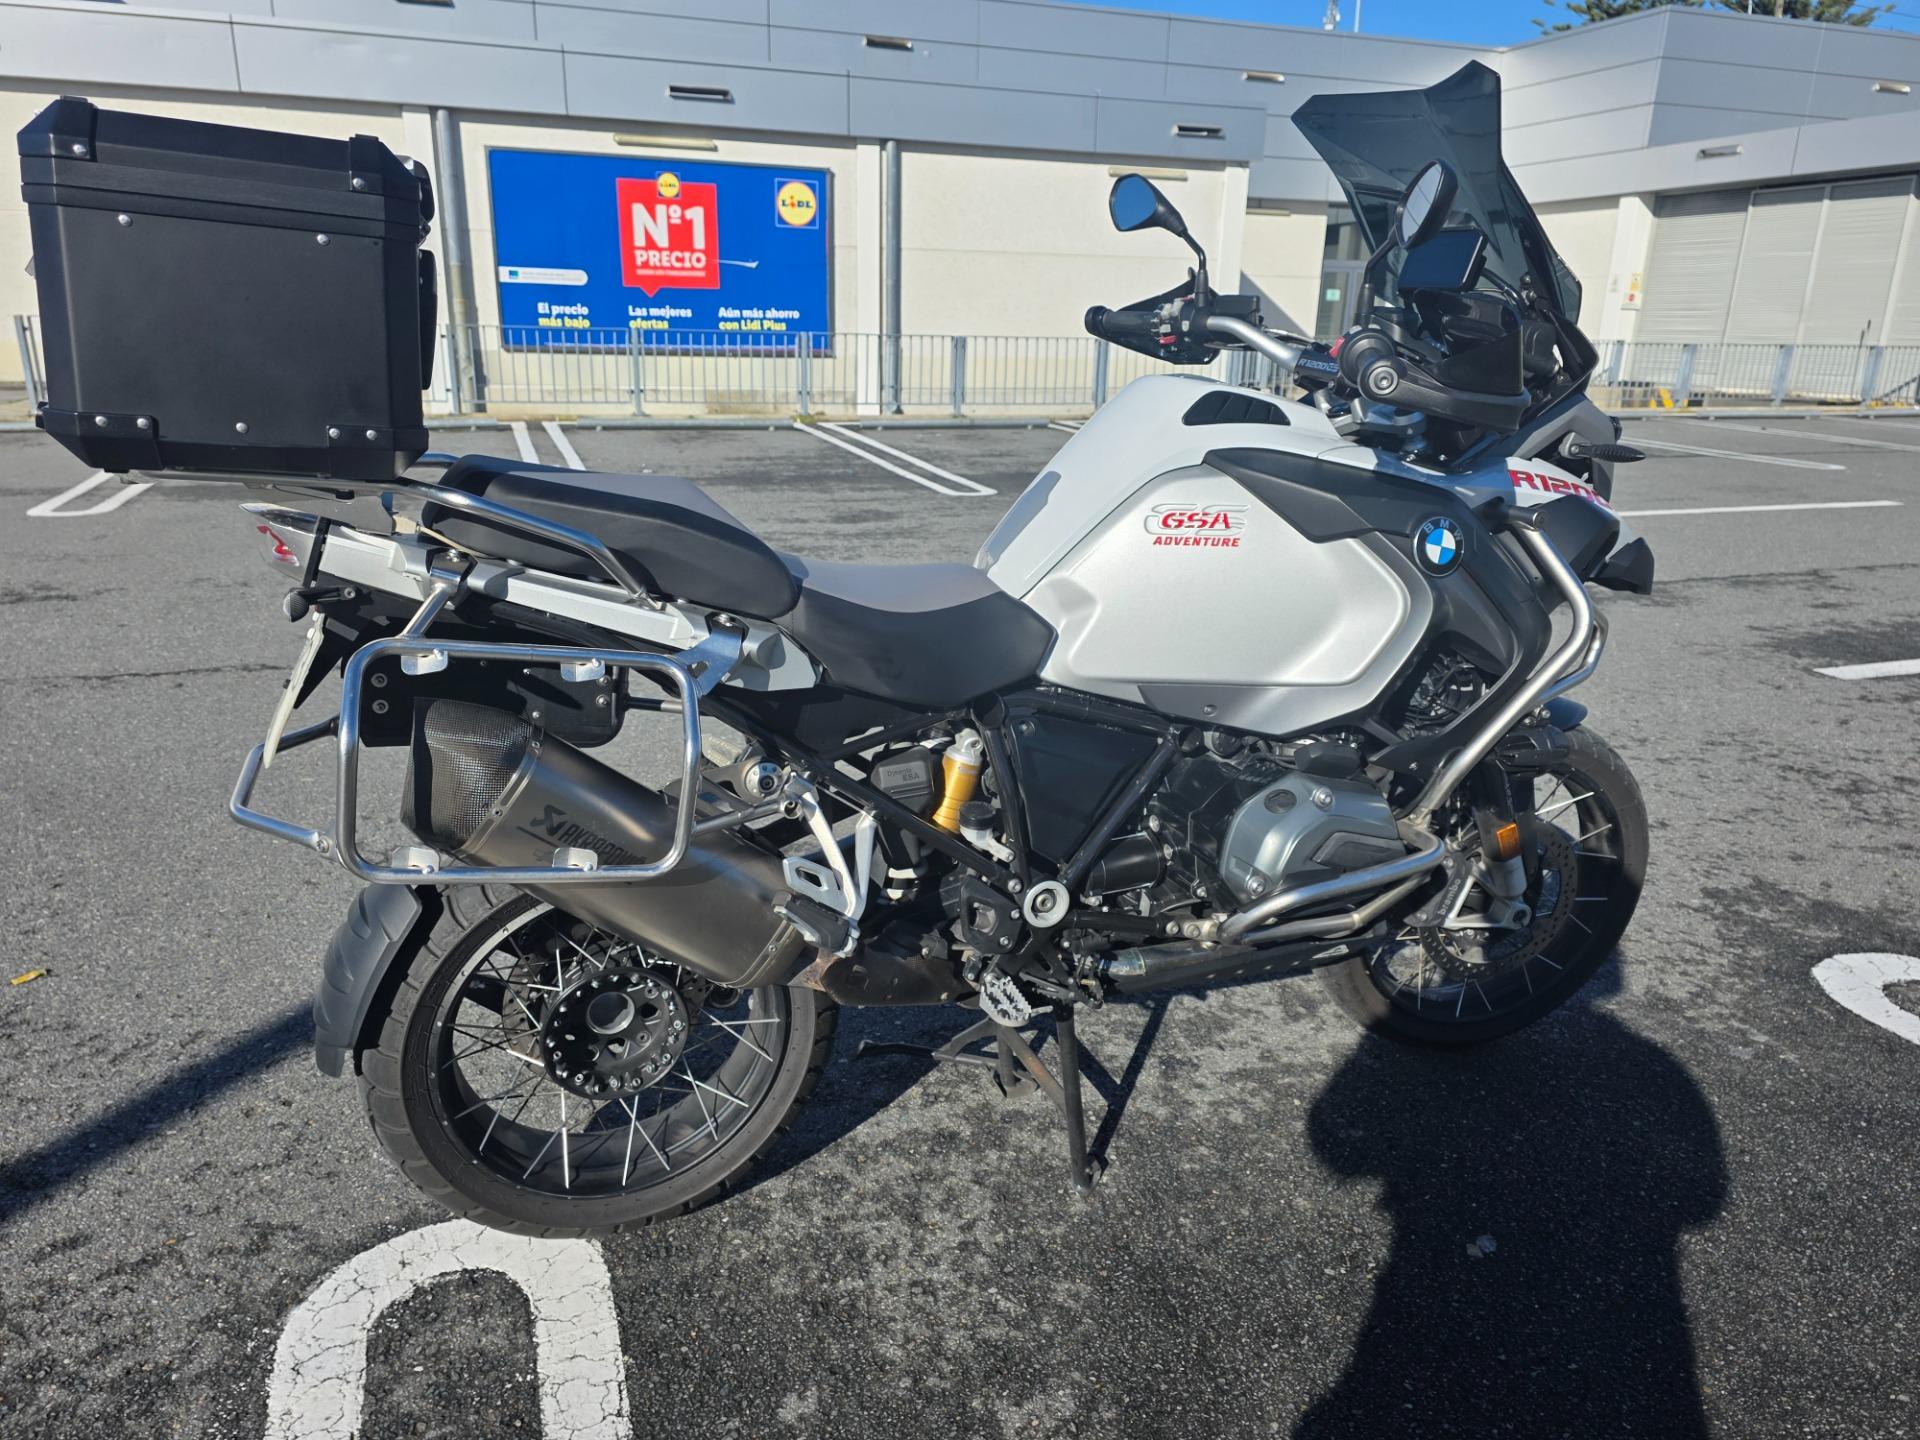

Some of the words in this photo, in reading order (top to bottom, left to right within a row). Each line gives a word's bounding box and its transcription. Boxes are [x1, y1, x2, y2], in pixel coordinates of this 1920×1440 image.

[781, 195, 813, 208] LIDL
[634, 249, 706, 269] PRECIO
[537, 302, 549, 314] El
[551, 303, 589, 318] precio
[628, 305, 647, 316] Las
[649, 305, 692, 319] mejores
[718, 307, 740, 318] Aún
[742, 308, 763, 318] más
[765, 307, 800, 319] ahorro
[538, 317, 562, 327] más
[564, 317, 590, 328] bajo
[629, 318, 669, 329] ofertas
[719, 321, 739, 330] con
[741, 319, 761, 330] Lidl
[763, 320, 786, 330] Plus
[1161, 512, 1231, 529] GSA
[1423, 518, 1463, 540] BMW
[1153, 536, 1240, 547] ADVENTURE
